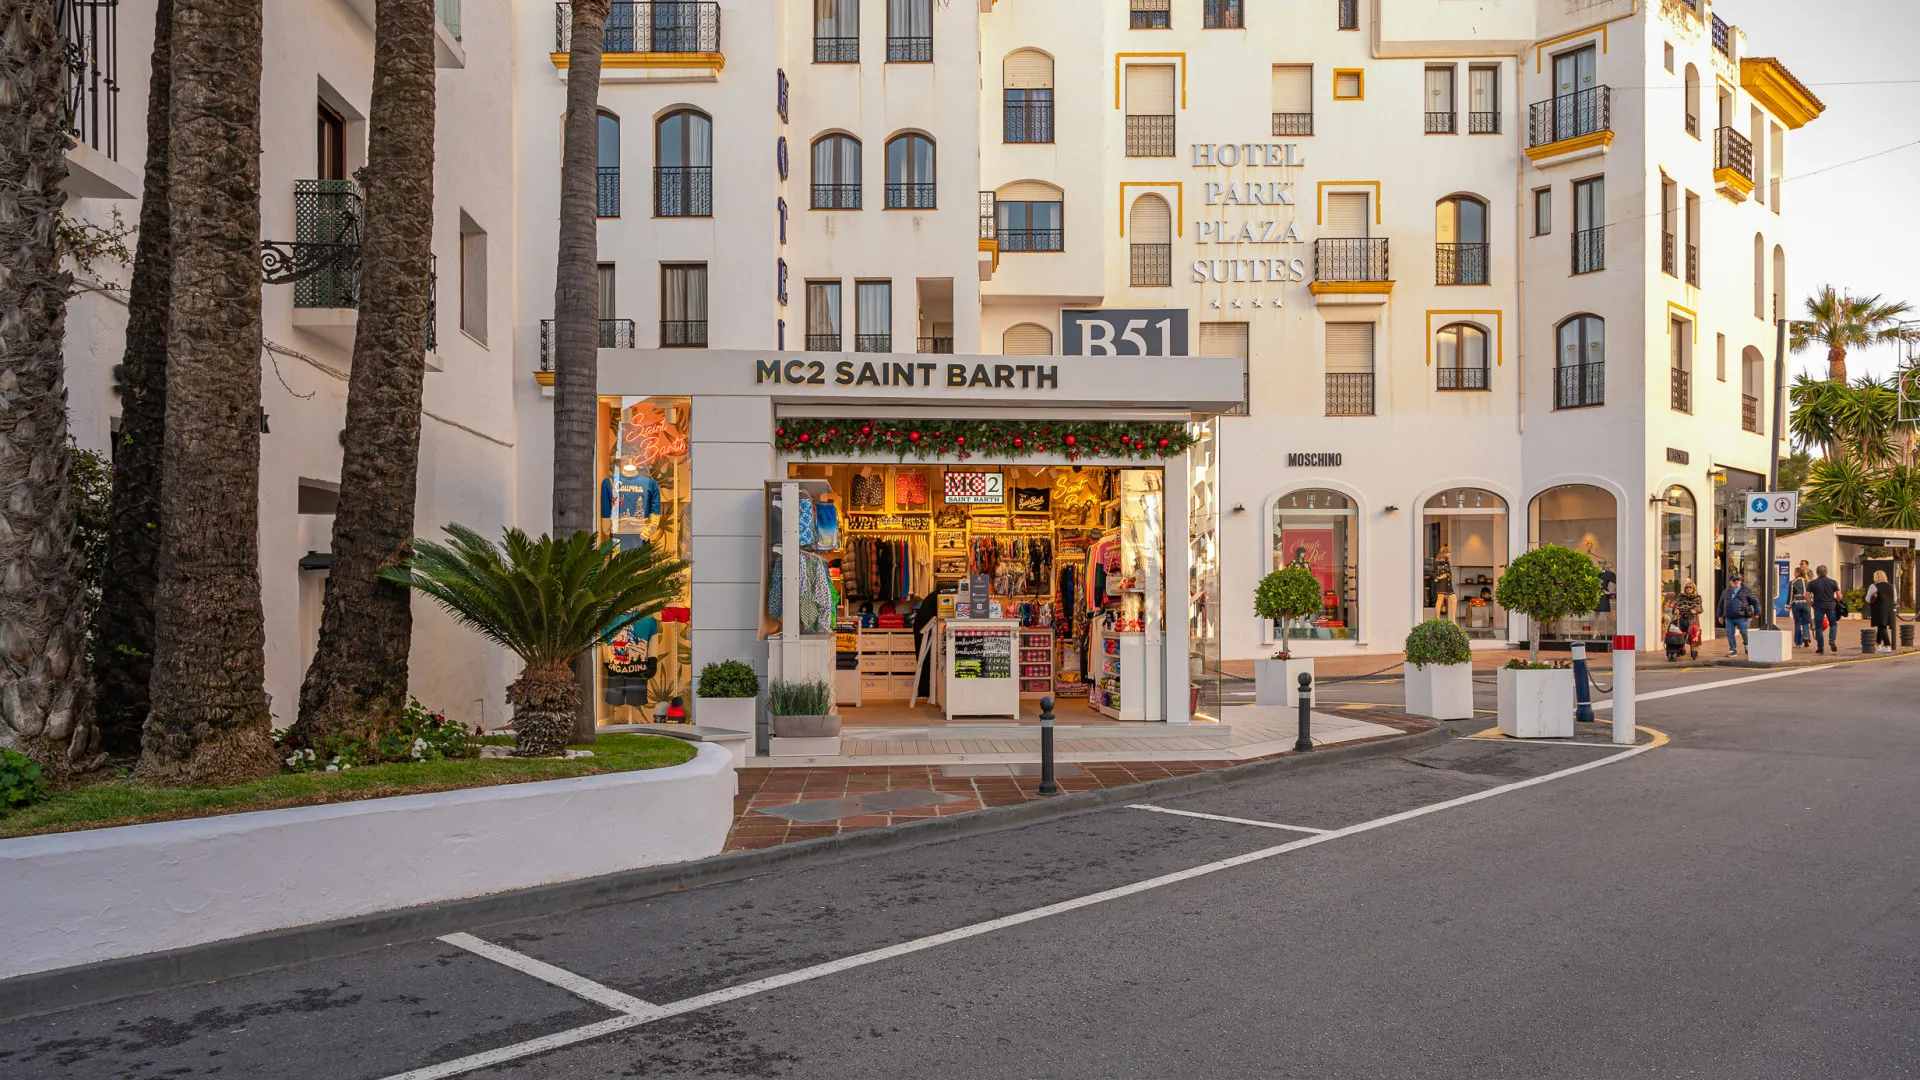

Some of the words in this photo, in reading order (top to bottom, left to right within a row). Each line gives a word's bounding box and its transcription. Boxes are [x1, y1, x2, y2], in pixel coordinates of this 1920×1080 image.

[1192, 143, 1305, 168] HOTEL
[1205, 182, 1295, 206] PARK
[1196, 221, 1305, 245] PLAZA
[1193, 259, 1305, 284] SUITES
[1076, 318, 1171, 356] B51
[756, 360, 826, 385] MC2
[834, 361, 938, 387] SAINT
[947, 363, 1059, 389] BARTH
[626, 413, 667, 442] Saint
[633, 437, 686, 465] Barth
[1288, 453, 1342, 467] MOSCHINO
[1053, 476, 1088, 499] Saint
